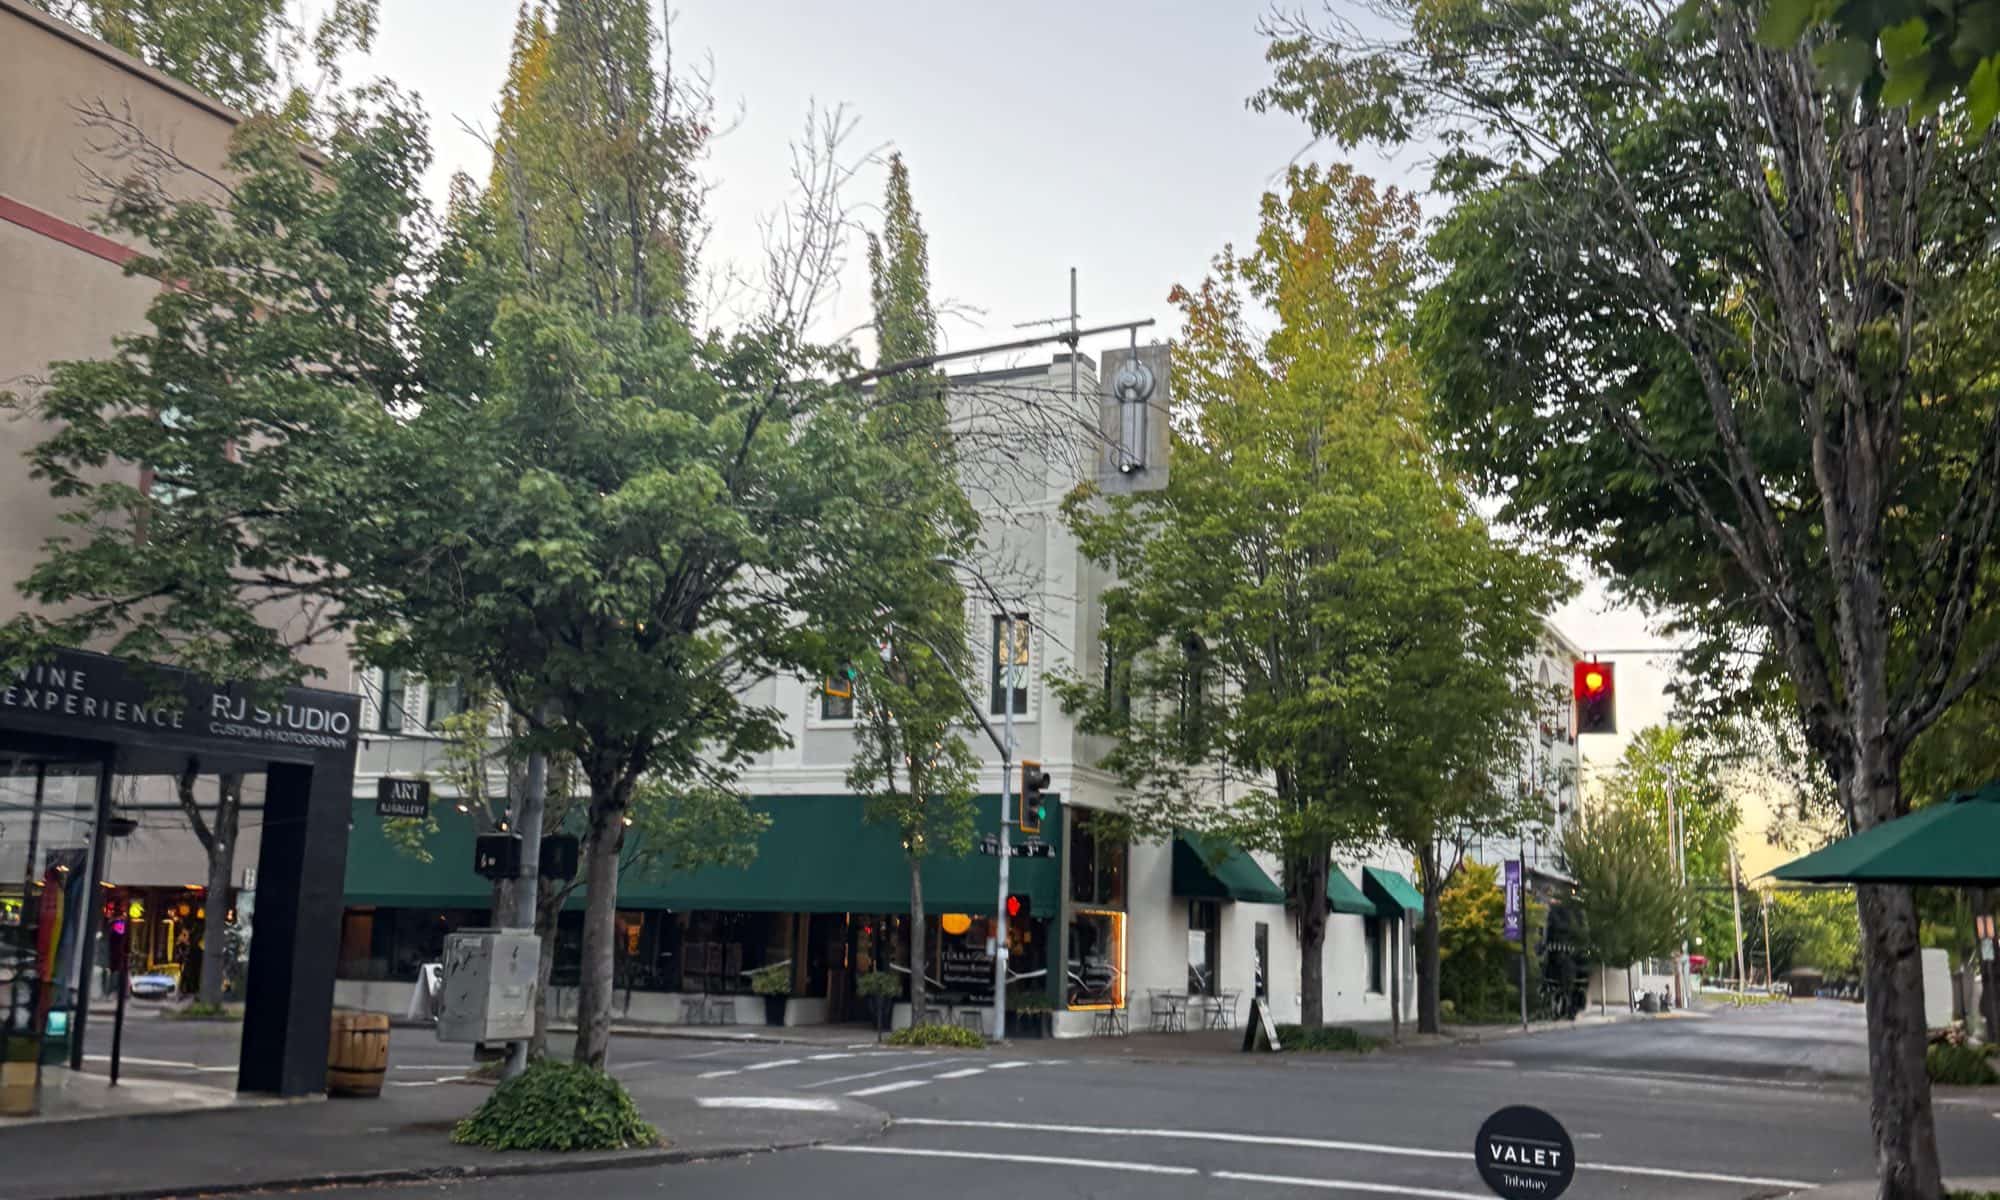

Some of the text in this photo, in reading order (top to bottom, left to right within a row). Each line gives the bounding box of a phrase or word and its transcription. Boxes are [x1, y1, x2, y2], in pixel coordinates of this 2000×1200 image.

[4, 686, 184, 729] EXPERIENCE
[211, 693, 350, 735] RJ STUDIO
[209, 721, 348, 749] CUSTOM PHOTOGRAPHY
[391, 782, 421, 800] ART
[1490, 1143, 1561, 1168] VALET
[1503, 1174, 1548, 1193] Tributary
